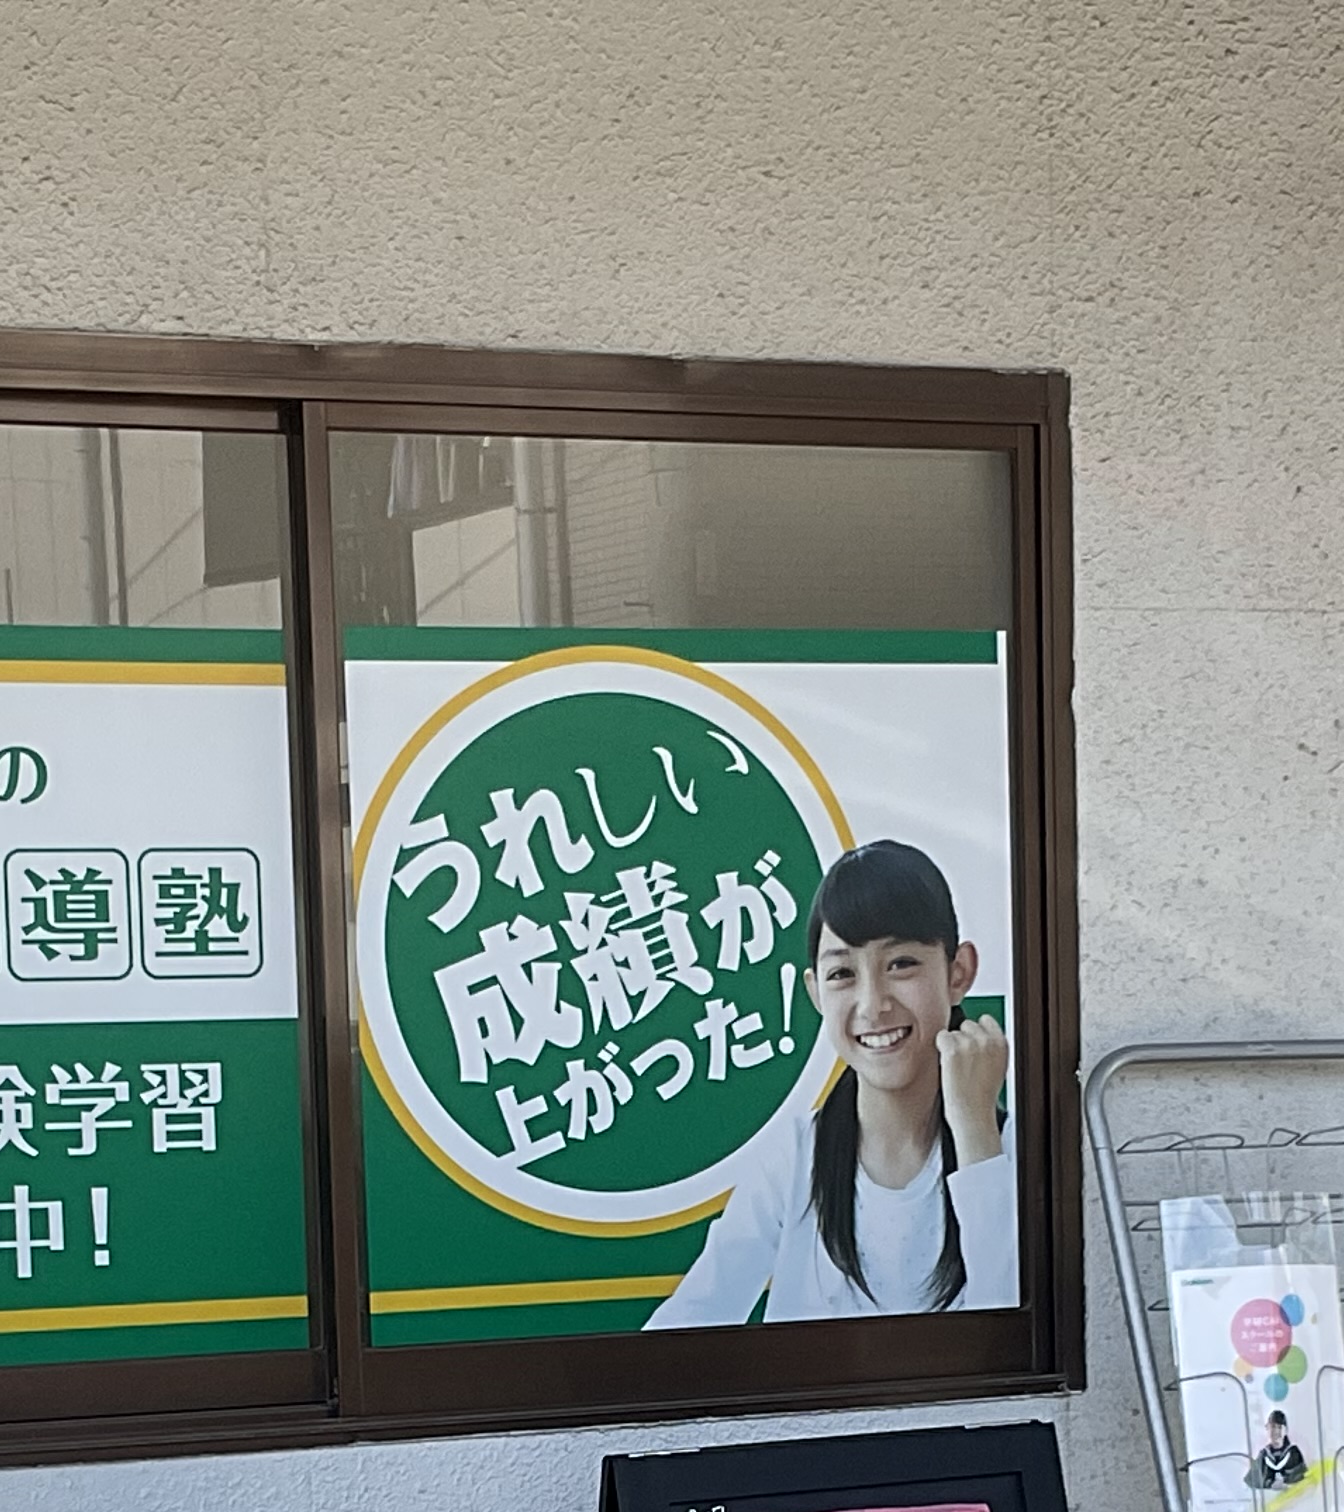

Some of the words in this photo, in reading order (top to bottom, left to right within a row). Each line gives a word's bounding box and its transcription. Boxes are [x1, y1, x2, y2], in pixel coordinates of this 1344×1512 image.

[393, 730, 749, 933] うれしい
[433, 850, 798, 1084] 成績が
[495, 962, 796, 1168] 上がった!
